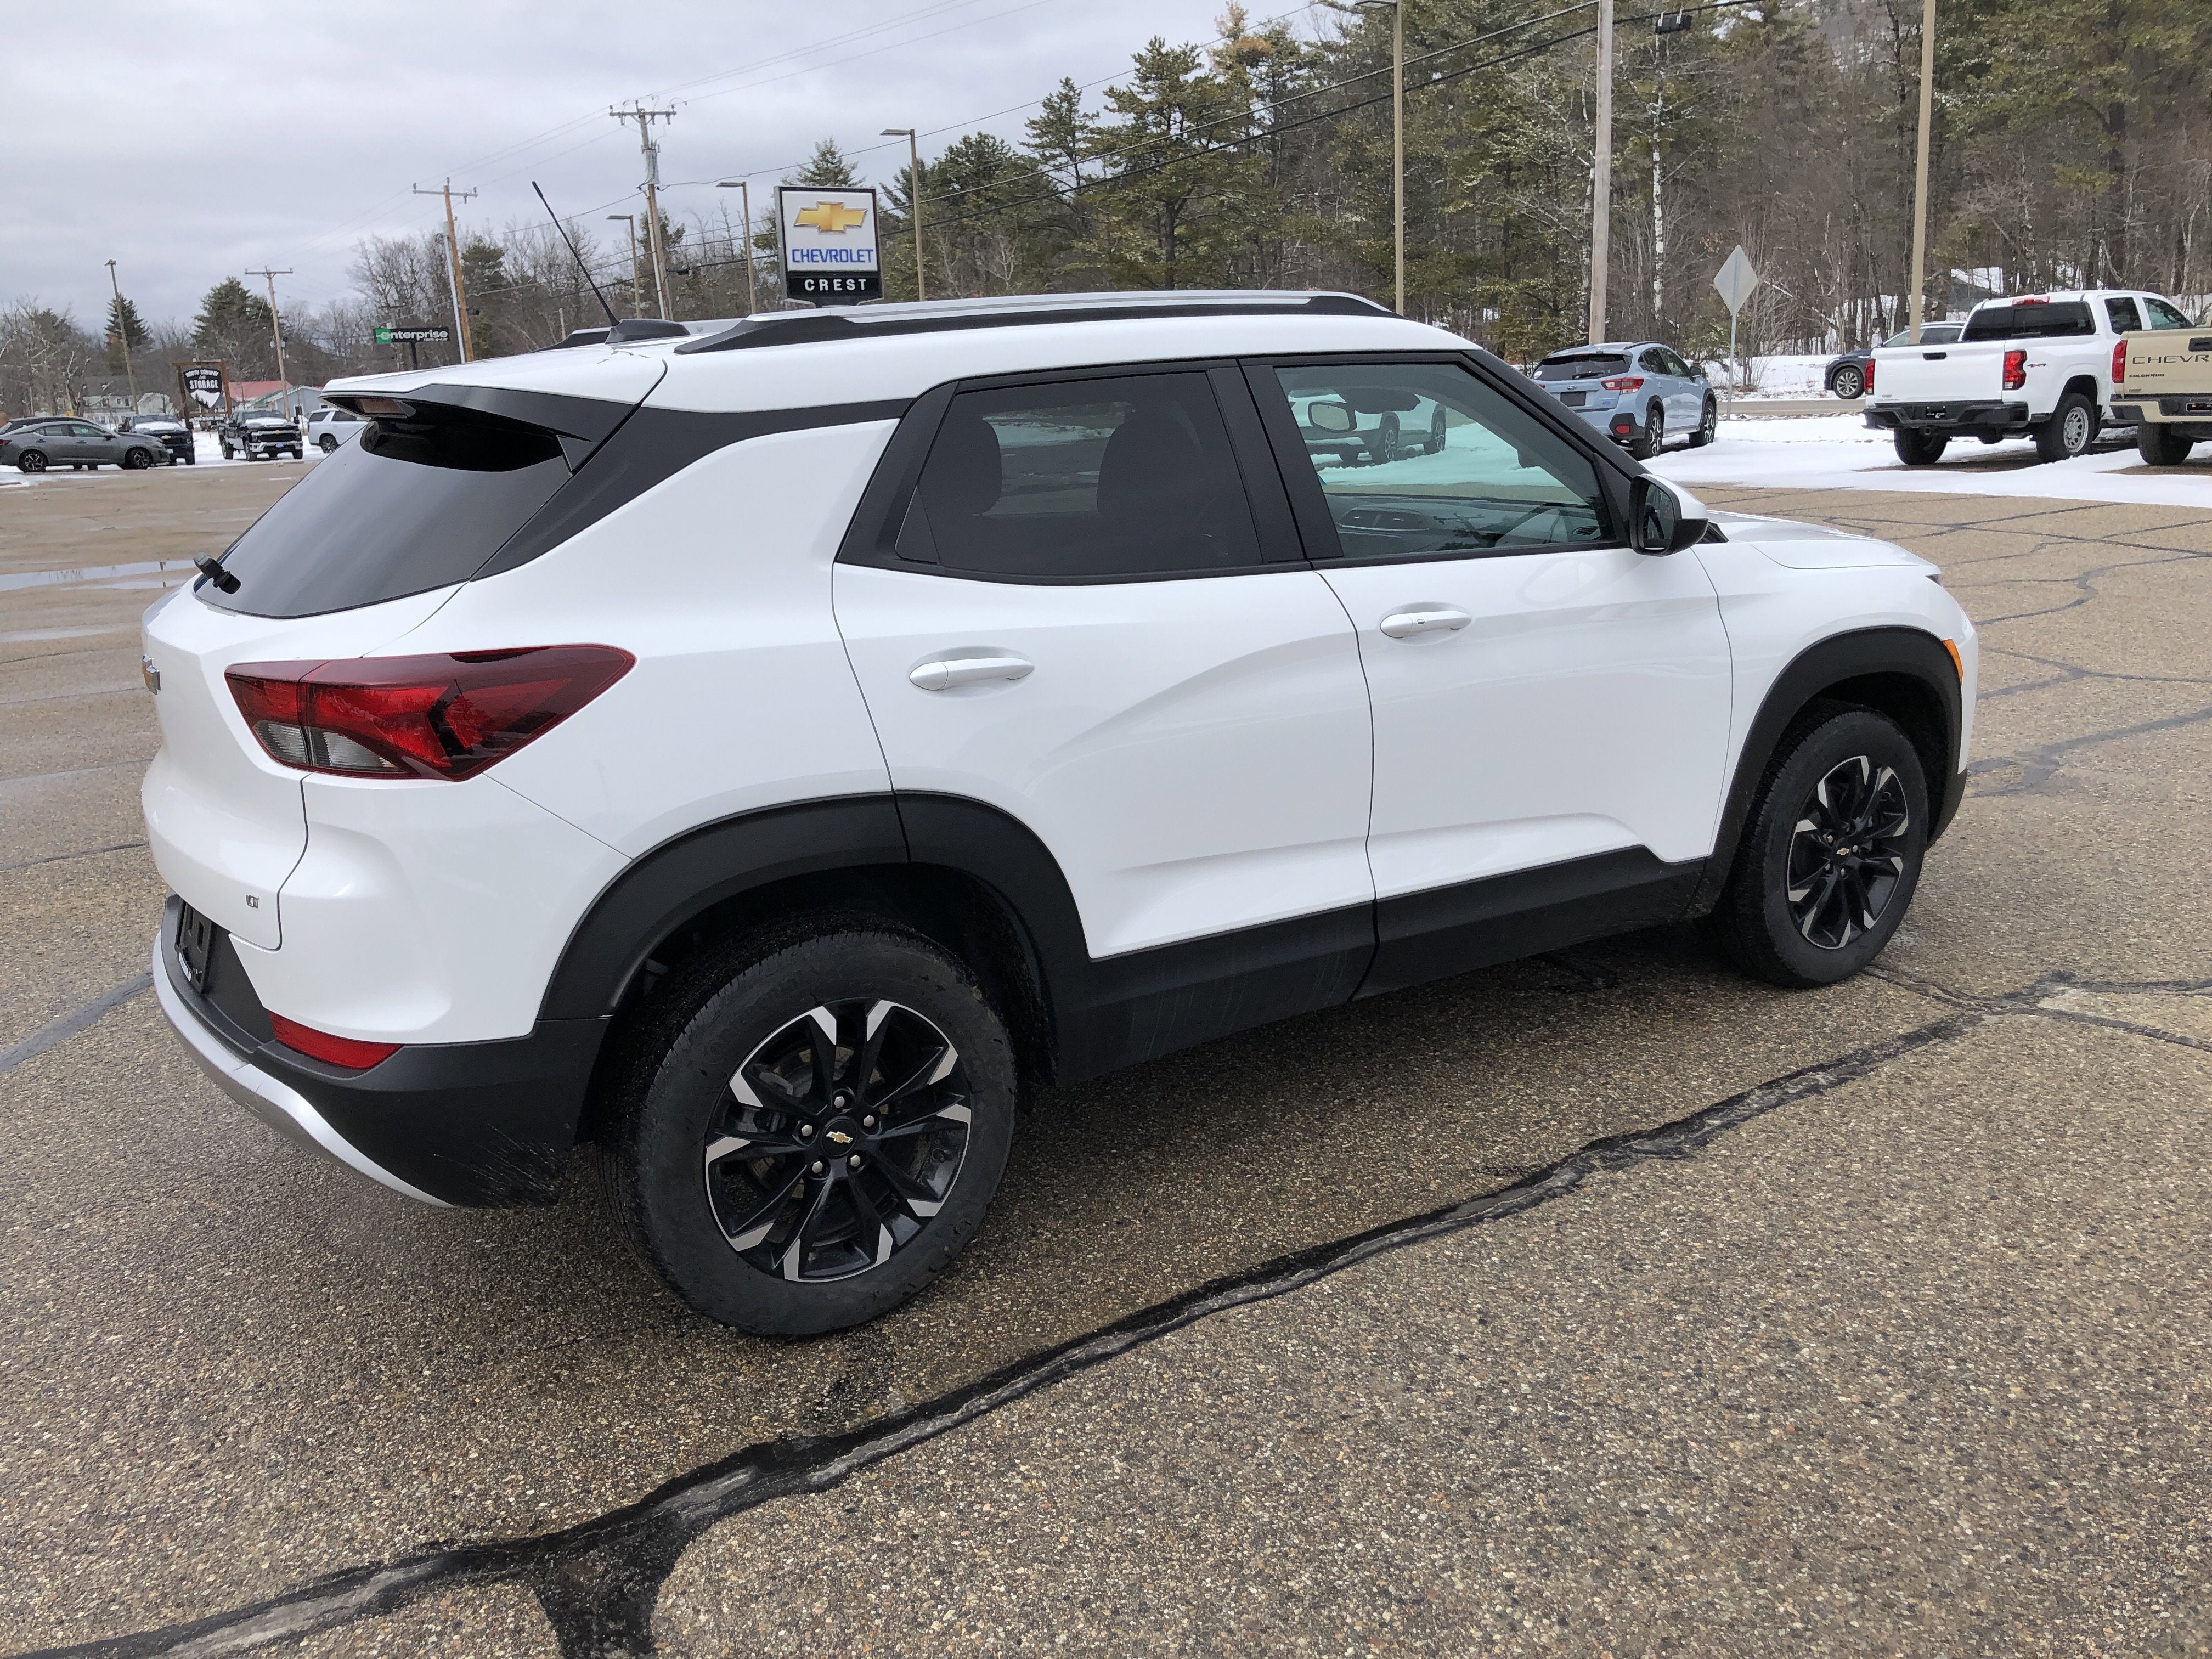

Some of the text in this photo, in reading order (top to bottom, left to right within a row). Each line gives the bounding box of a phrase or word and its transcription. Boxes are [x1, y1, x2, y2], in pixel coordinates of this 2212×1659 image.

[792, 249, 873, 263] CHEVROLET
[804, 279, 867, 291] CREST
[380, 329, 448, 341] enterprise
[189, 379, 219, 389] STORAGE
